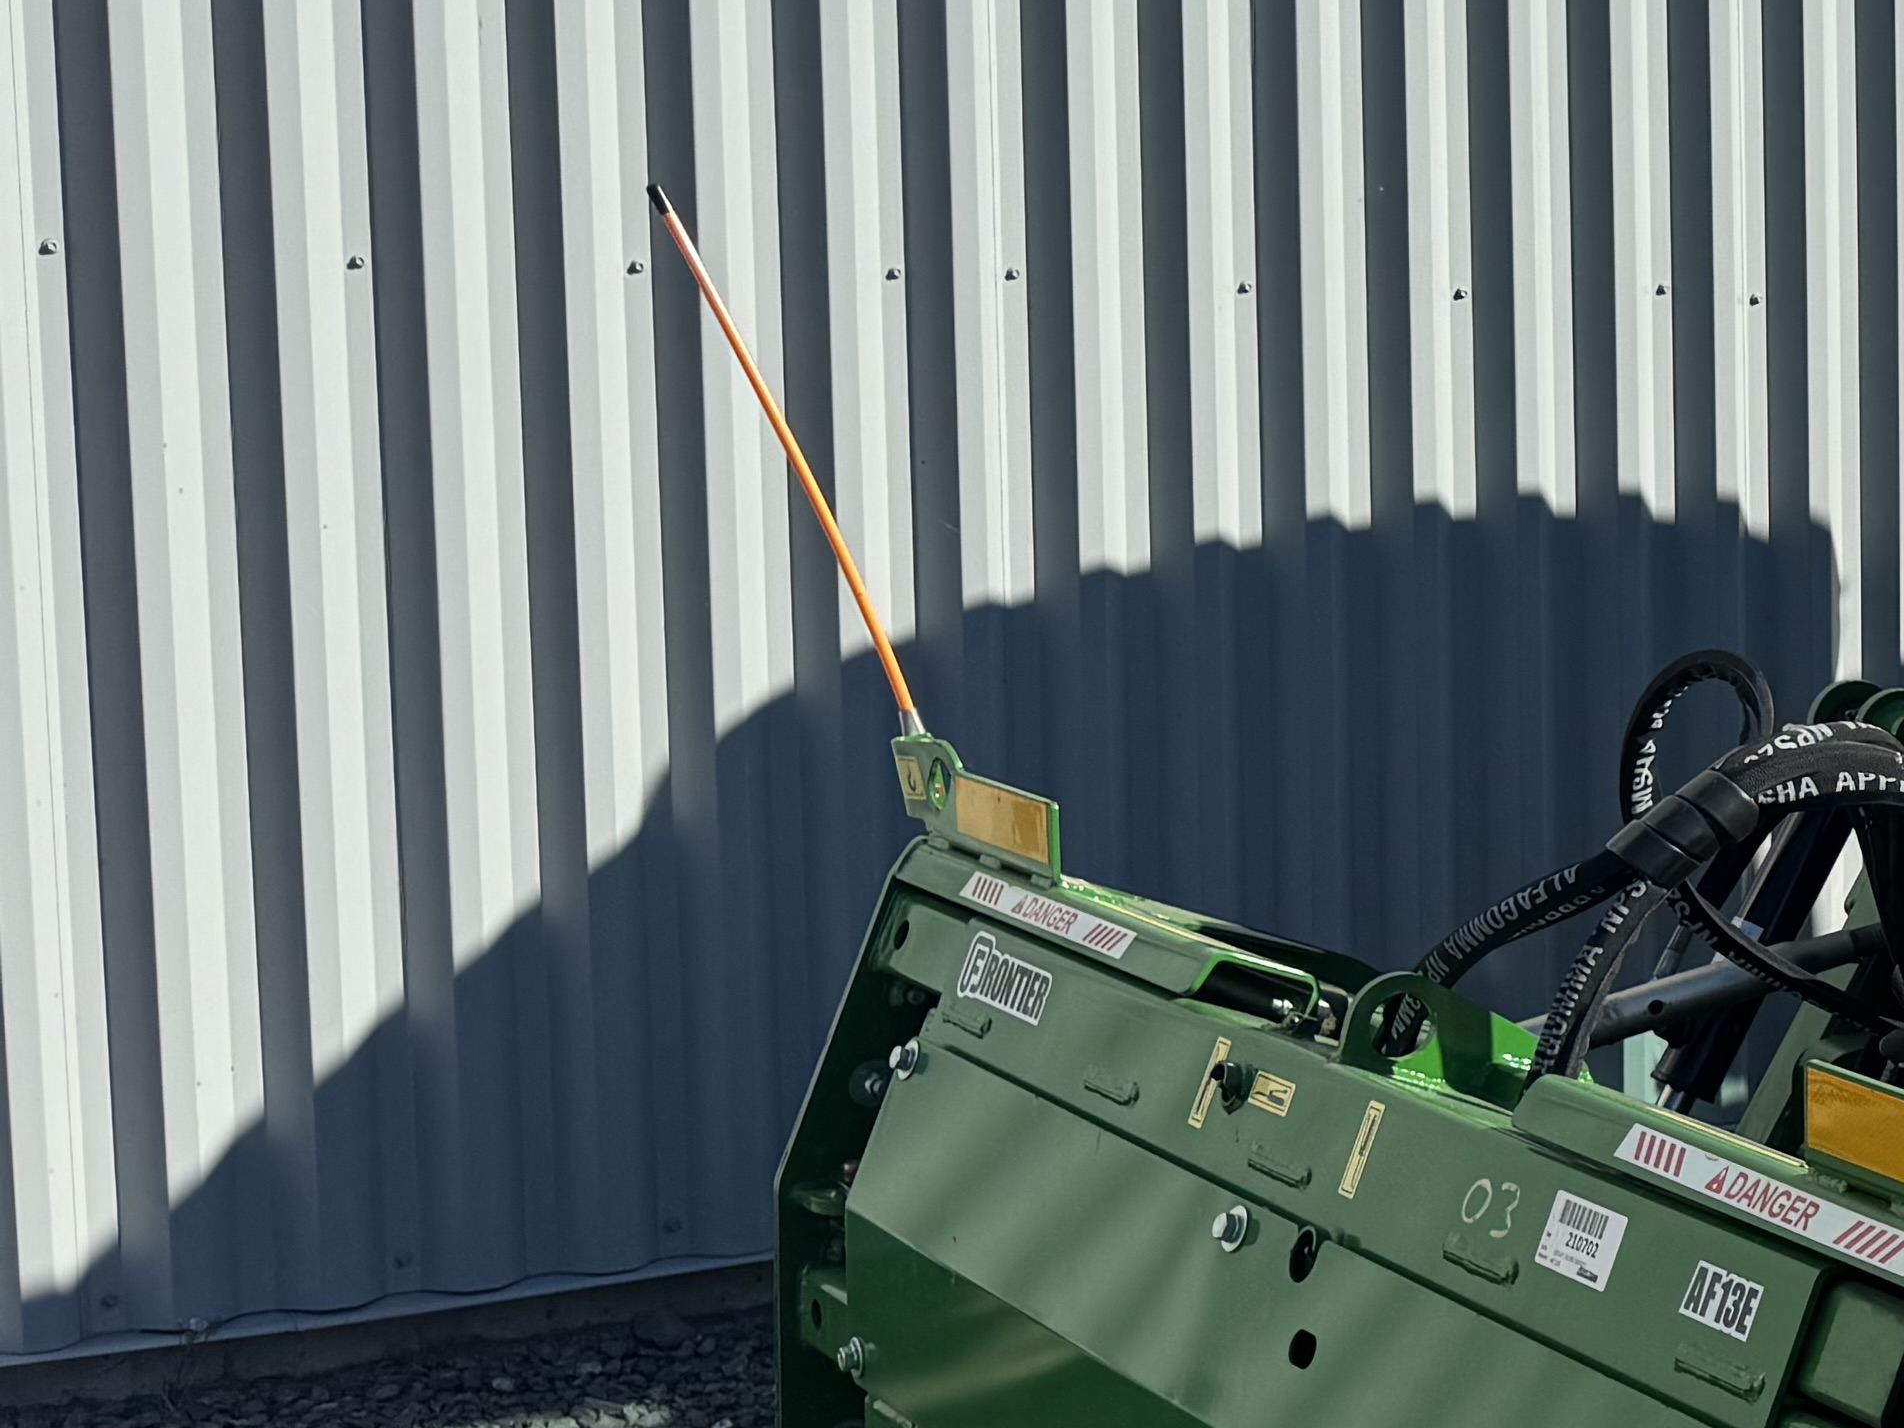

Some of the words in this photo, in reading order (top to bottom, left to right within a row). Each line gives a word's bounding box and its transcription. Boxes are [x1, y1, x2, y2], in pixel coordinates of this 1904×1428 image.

[1022, 897, 1079, 935] DANGER
[961, 935, 1051, 1021] FRONTIER
[1724, 1171, 1821, 1232] DANGER
[1565, 1231, 1600, 1259] 210702
[1683, 1265, 1760, 1335] AF13E
